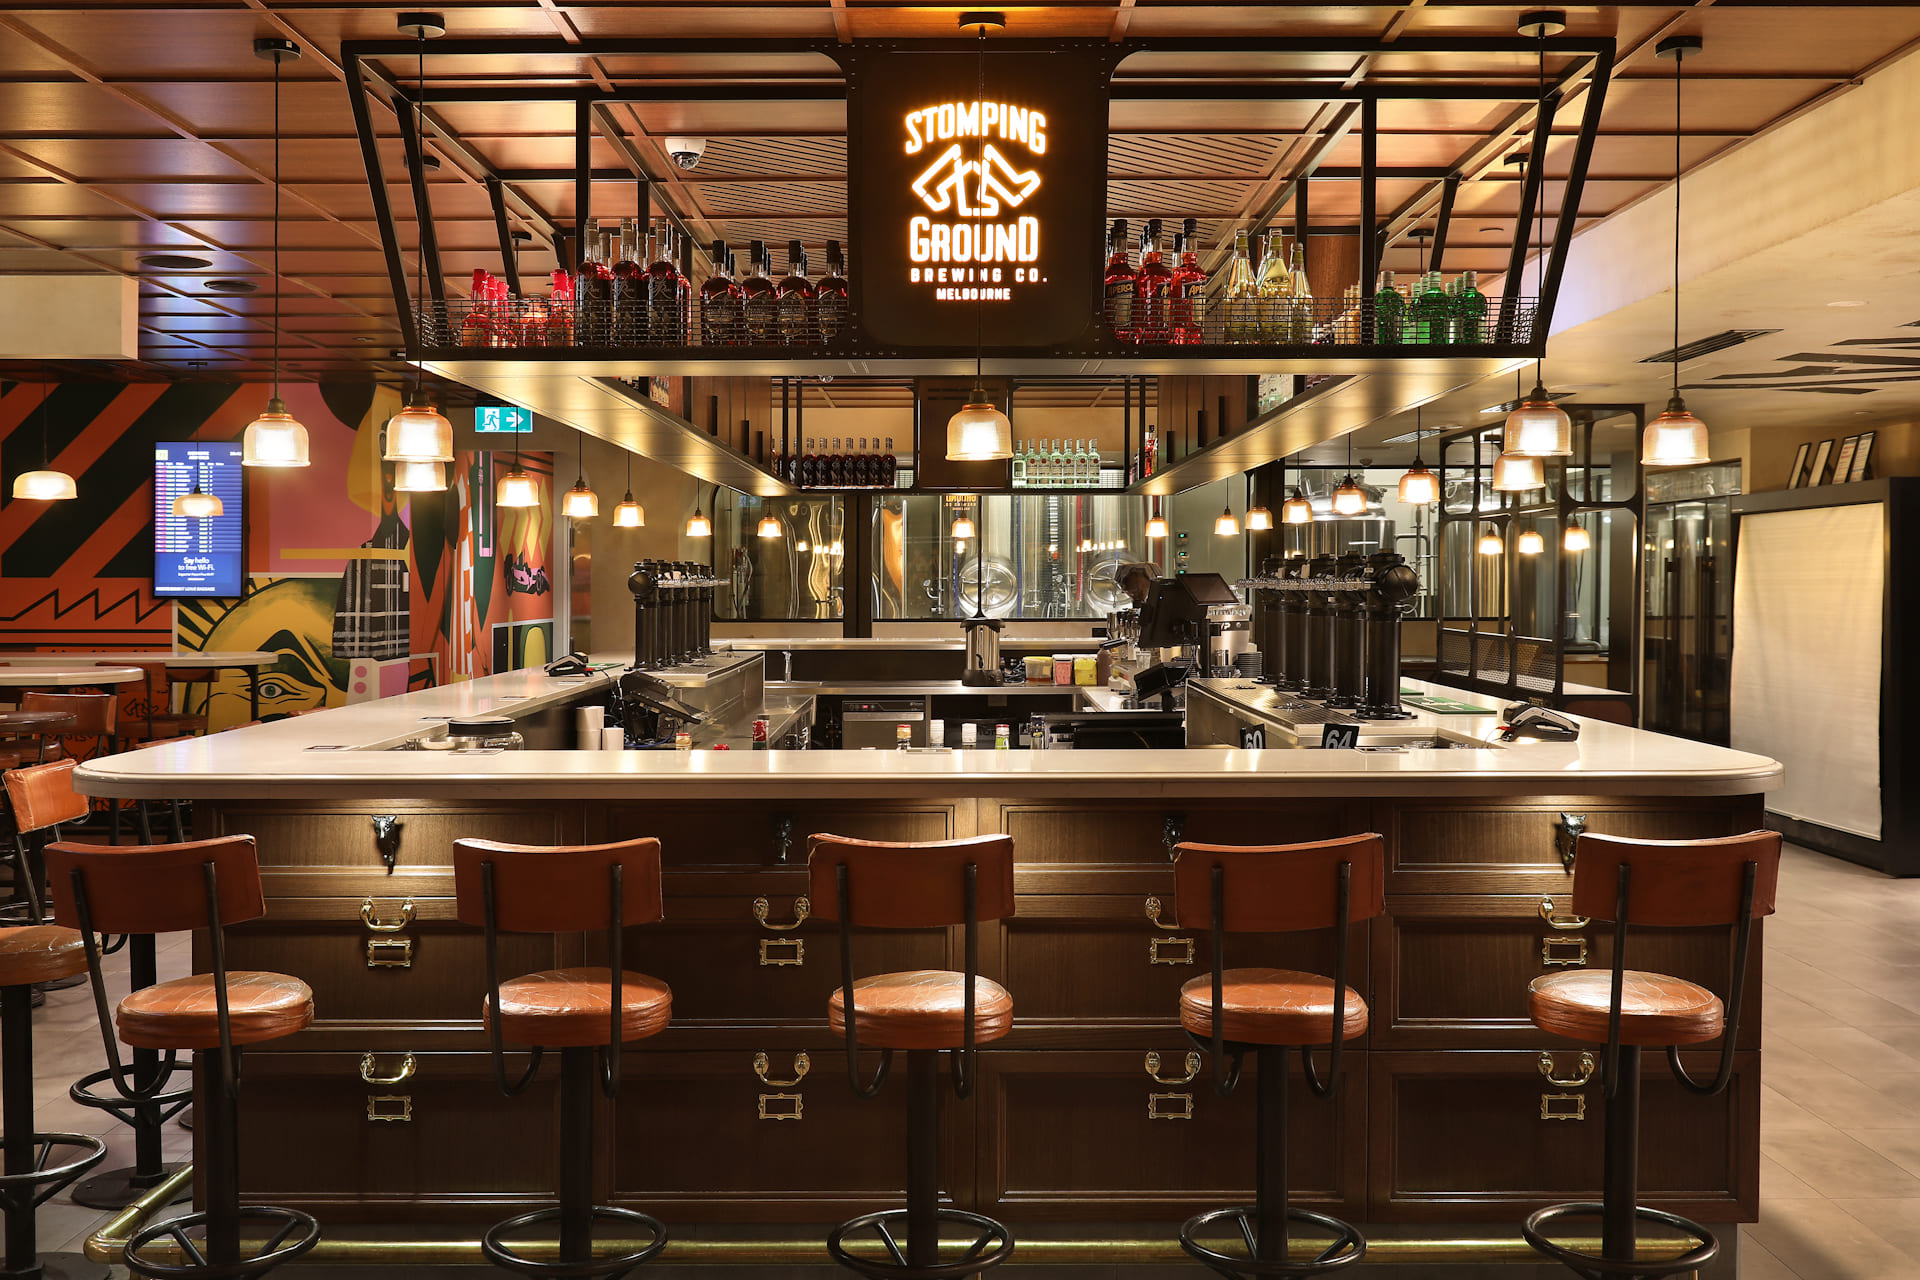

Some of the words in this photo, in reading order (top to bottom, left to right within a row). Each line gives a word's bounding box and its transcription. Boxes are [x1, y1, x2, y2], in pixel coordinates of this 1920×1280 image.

[905, 101, 1047, 155] STOMPING
[909, 216, 1039, 262] GROUND
[910, 267, 1002, 283] BREWING
[1015, 267, 1048, 283] CO.
[936, 287, 1011, 301] MELBOURNE
[183, 556, 194, 566] Say
[195, 556, 210, 564] hello
[1325, 729, 1353, 749] 64
